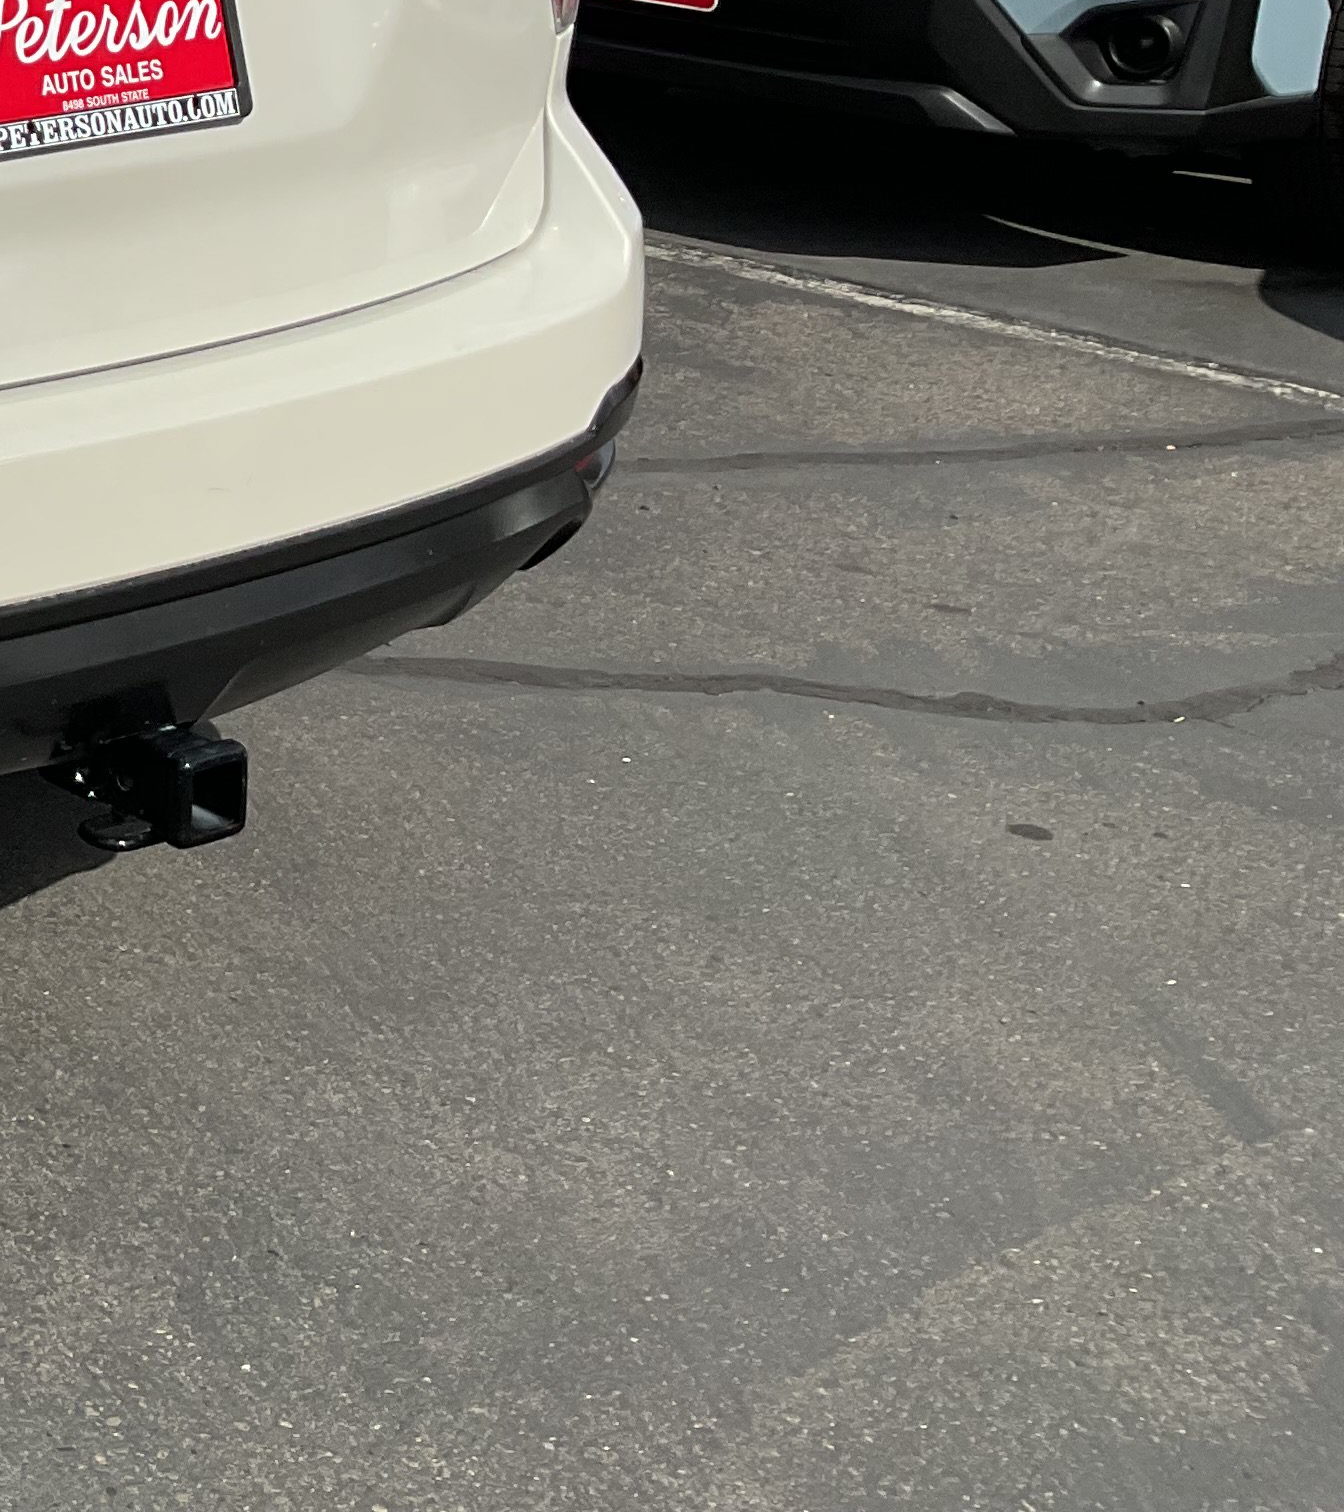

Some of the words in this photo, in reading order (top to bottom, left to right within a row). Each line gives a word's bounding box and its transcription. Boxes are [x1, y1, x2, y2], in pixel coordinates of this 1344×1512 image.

[41, 68, 96, 96] AUTO
[101, 59, 163, 88] SALES
[86, 93, 119, 108] SOUTH
[121, 88, 150, 103] STATE
